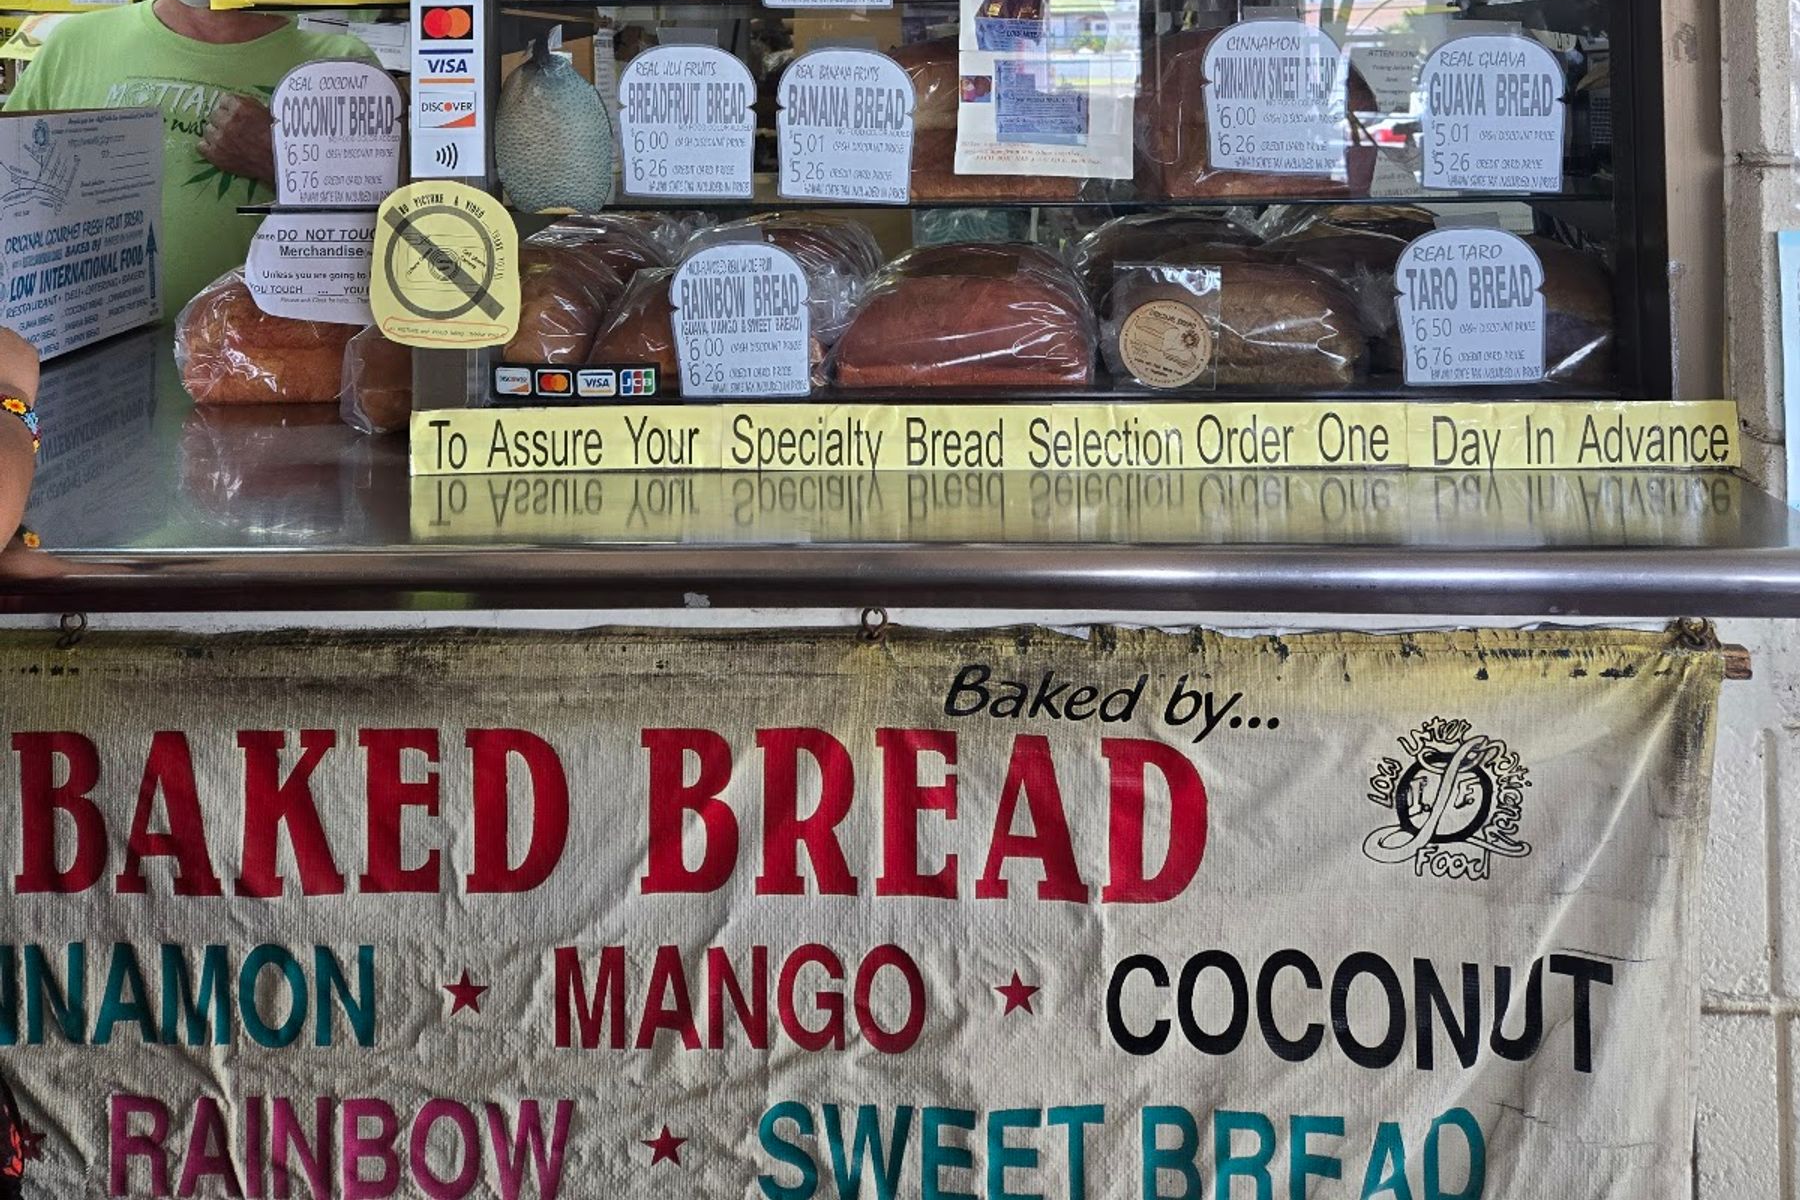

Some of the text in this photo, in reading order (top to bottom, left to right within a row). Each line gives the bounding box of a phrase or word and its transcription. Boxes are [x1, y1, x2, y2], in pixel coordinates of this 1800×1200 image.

[1227, 35, 1300, 51] CINNAMON
[427, 58, 468, 73] VISA
[635, 61, 659, 77] REAL
[1440, 50, 1526, 67] REAL GUAVA
[288, 75, 368, 91] REAL COCONUT
[1213, 57, 1300, 100] CINNAMON SWEET
[421, 101, 473, 113] DISCOVER
[628, 82, 746, 125] BREADFRUIT BREAD
[787, 84, 905, 130] BANANA BREAD
[1429, 72, 1487, 117] GUAVA
[1496, 73, 1553, 117] BREAD
[282, 95, 394, 139] COCONUT BREAD
[1217, 104, 1256, 129] $6.00
[630, 127, 668, 153] $6.00
[789, 130, 825, 156] $5.01
[1218, 131, 1256, 156] $6.26
[1431, 119, 1470, 144] $5.01
[284, 142, 319, 165] $6.50
[285, 169, 319, 192] $6.76
[277, 229, 335, 241] DO NOT
[279, 245, 364, 258] Merchandise
[1413, 244, 1502, 262] REAL TARO
[10, 245, 143, 302] LOW INTERNATIONAL FOOD
[262, 270, 293, 280] Unless
[330, 272, 354, 282] going
[270, 284, 303, 294] TOUCH
[681, 273, 799, 320] RAINBOW BREAD
[1405, 264, 1533, 311] TARO BREAD
[584, 377, 609, 389] VISA
[429, 412, 1730, 471] To Assure Your Specialty Bread Selection Order One Day In Advance
[943, 664, 1281, 743] Baked by...
[11, 726, 1208, 904] BAKED BREAD
[1415, 844, 1491, 881] Food
[0, 942, 1614, 1074] NAMON MANGO COCONUT
[107, 1094, 1486, 1200] RAINBOW SWEET BREAD
